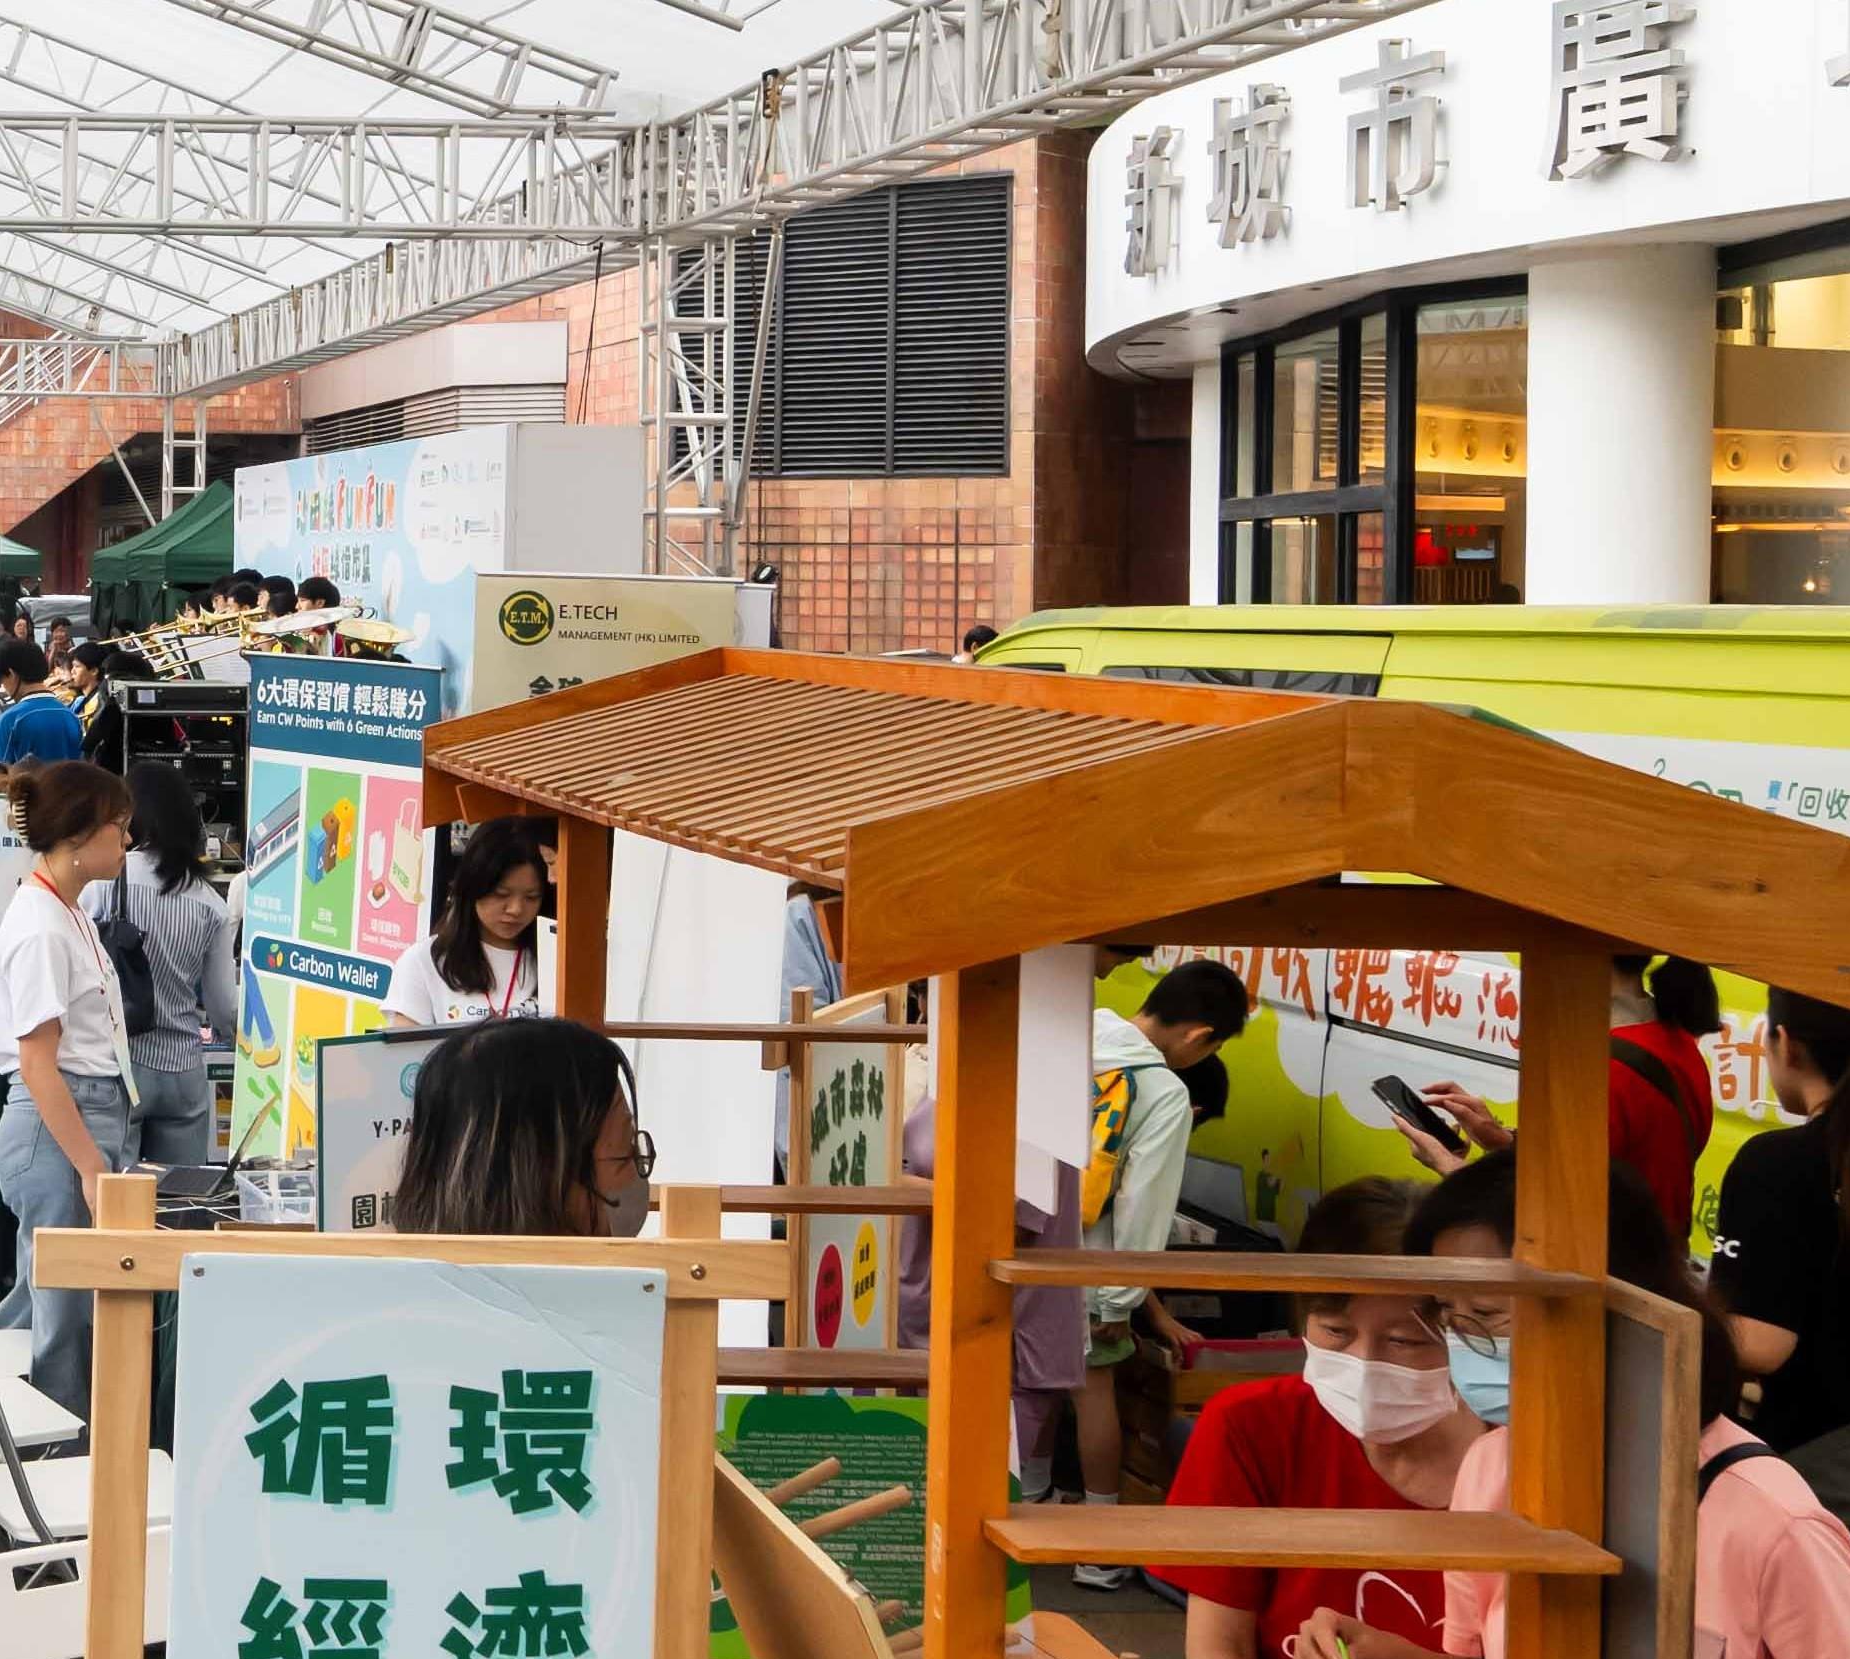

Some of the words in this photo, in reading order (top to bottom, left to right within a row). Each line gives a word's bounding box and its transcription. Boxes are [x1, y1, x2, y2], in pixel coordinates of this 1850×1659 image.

[510, 612, 544, 625] E.T.M.
[559, 604, 618, 621] E.TECH
[558, 630, 632, 642] MANAGEMENT
[634, 631, 656, 643] (HK)
[659, 633, 700, 644] LIMITED
[257, 710, 276, 725] Earn
[278, 713, 294, 726] CW
[295, 715, 324, 730] Points
[325, 718, 345, 732] with
[347, 720, 353, 734] 6
[356, 722, 384, 737] Green
[386, 724, 423, 741] Actions
[289, 949, 335, 980] Carbon
[338, 960, 379, 991] Wallet
[373, 1118, 414, 1139] Y·PA
[244, 1369, 595, 1516] 循環
